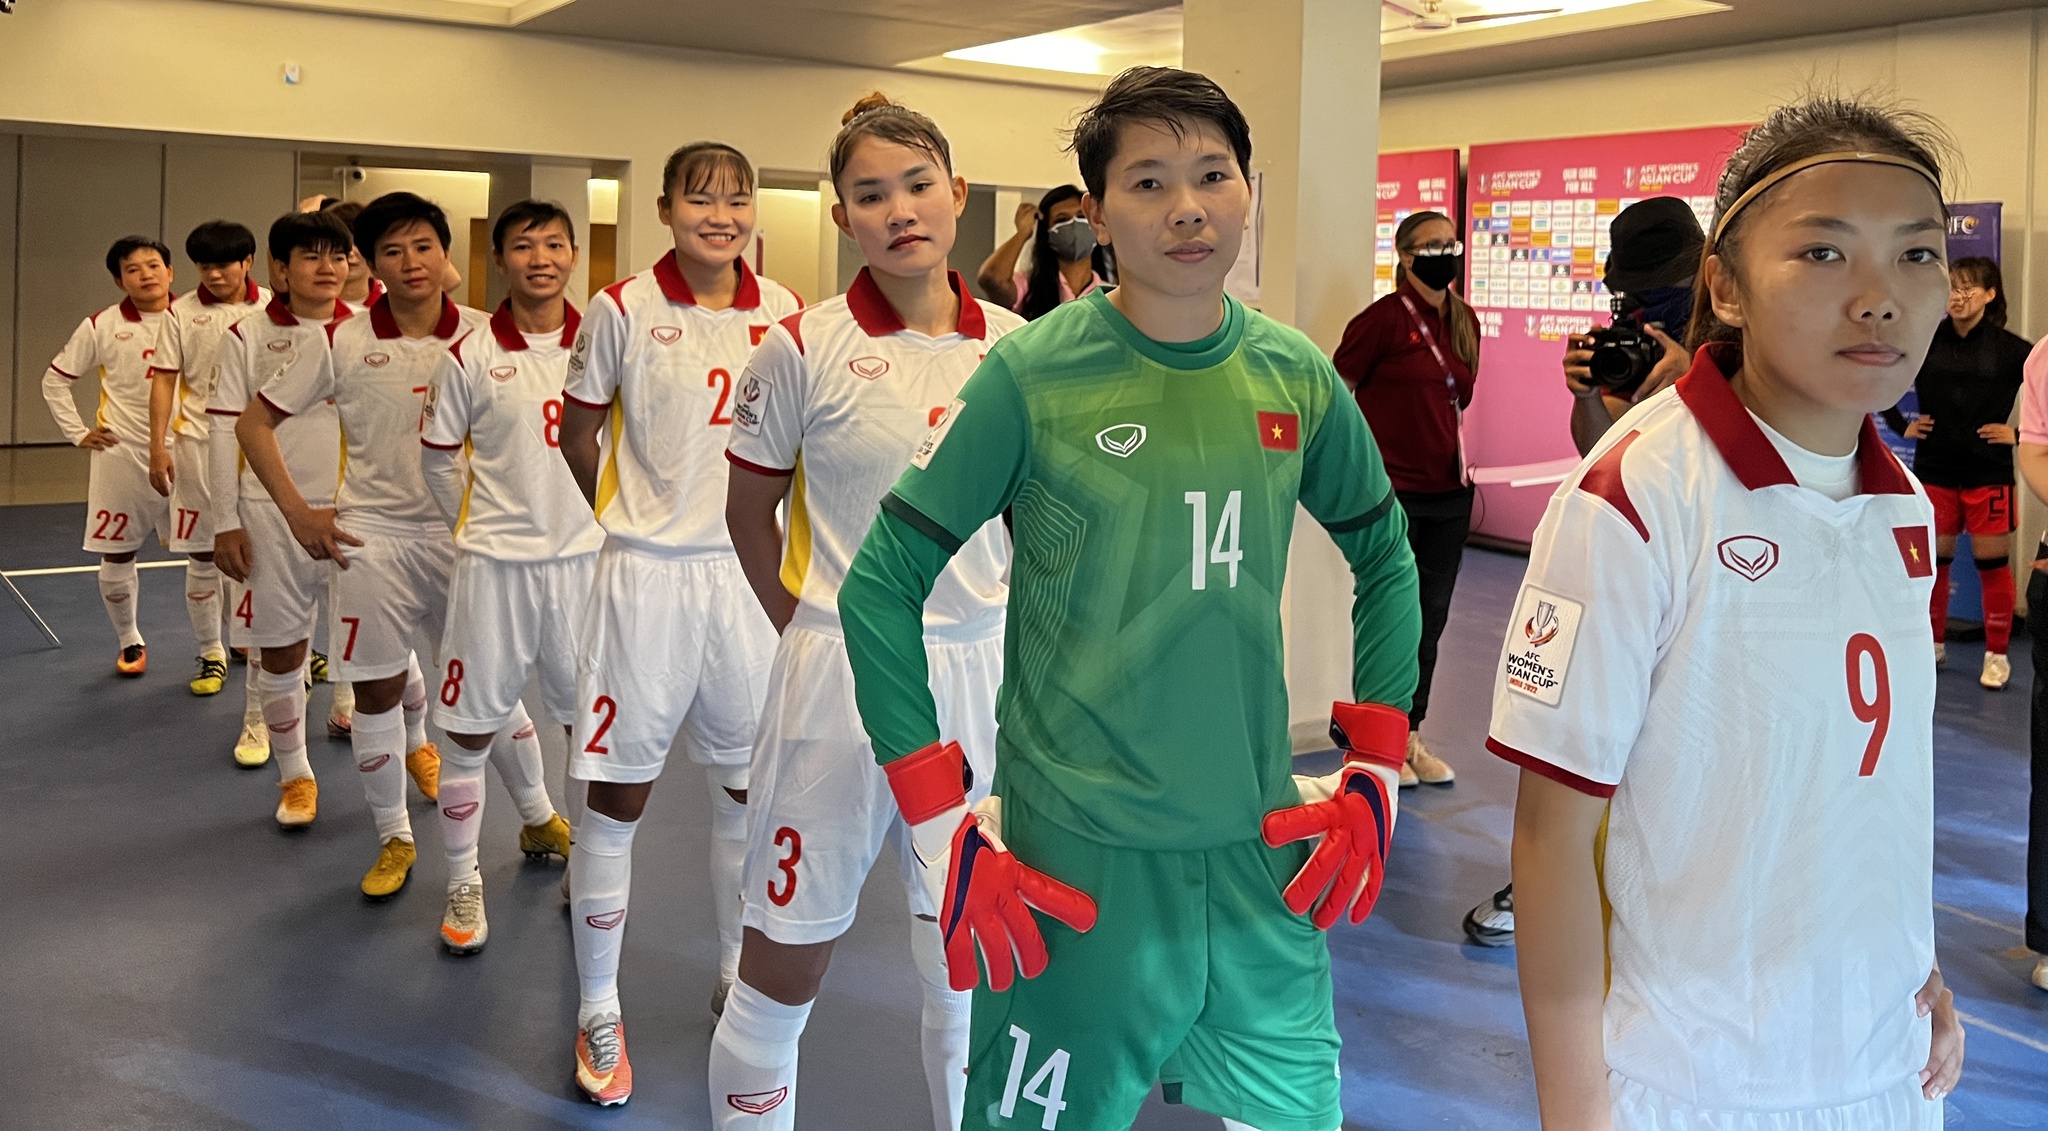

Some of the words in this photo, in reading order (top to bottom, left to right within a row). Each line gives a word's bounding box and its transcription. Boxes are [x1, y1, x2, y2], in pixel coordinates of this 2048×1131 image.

[1491, 179, 1518, 191] ASIAN
[1518, 178, 1539, 191] CUP
[1563, 168, 1577, 181] OUR
[1579, 167, 1598, 181] GOAL
[1639, 173, 1671, 185] ASIAN
[1672, 173, 1697, 185] CUP
[1640, 164, 1657, 174] AFC
[1565, 181, 1579, 194] FOR
[1580, 180, 1594, 194] ALL
[1539, 323, 1568, 336] ASIAN
[707, 367, 734, 426] 2
[542, 398, 564, 448] 8
[93, 510, 128, 541] 22
[177, 508, 200, 540] 17
[1184, 490, 1243, 590] 14
[236, 591, 254, 628] 4
[342, 617, 360, 661] 7
[1524, 650, 1541, 662] AFC
[1508, 652, 1554, 678] WOMEN'S
[441, 659, 464, 706] 8
[1846, 633, 1891, 777] 9
[584, 694, 617, 755] 2
[767, 826, 803, 907] 3
[999, 1024, 1071, 1131] 14
